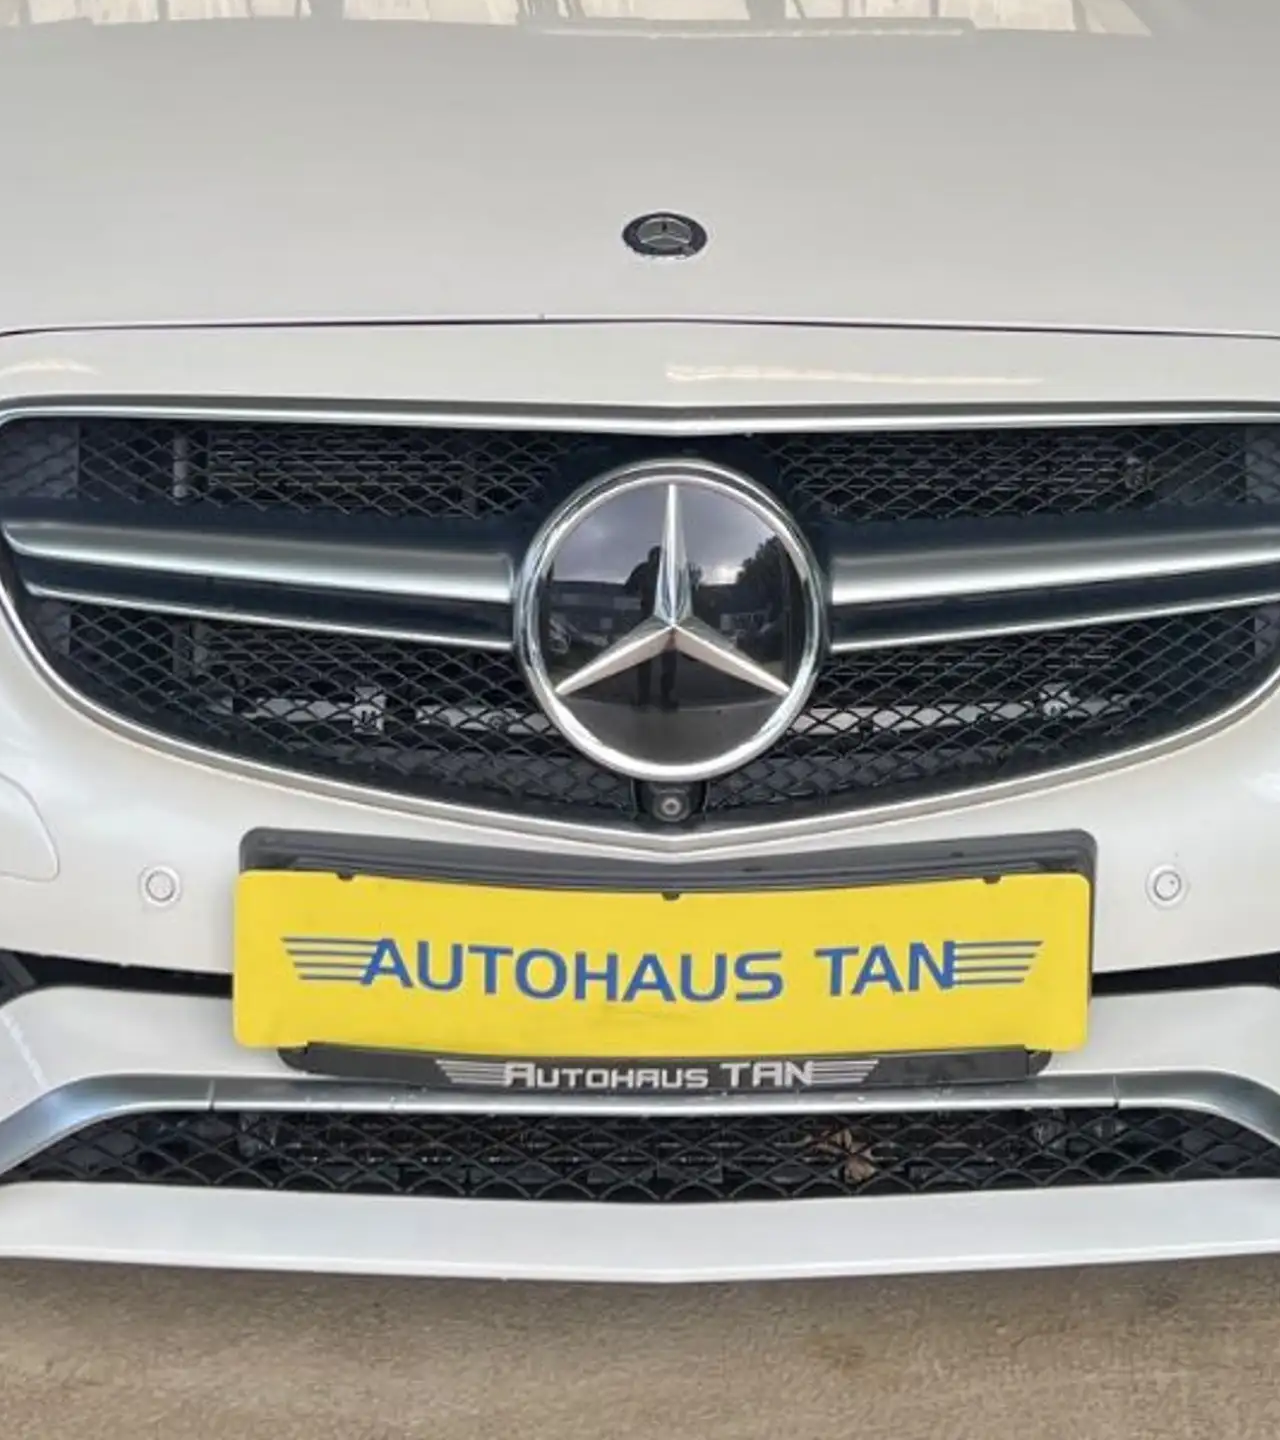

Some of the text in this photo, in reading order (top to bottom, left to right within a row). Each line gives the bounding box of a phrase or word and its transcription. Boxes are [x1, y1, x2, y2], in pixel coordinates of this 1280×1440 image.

[360, 937, 955, 1003] AUTOHAUS TAN
[506, 1060, 812, 1090] AUTOHAUS TAN
